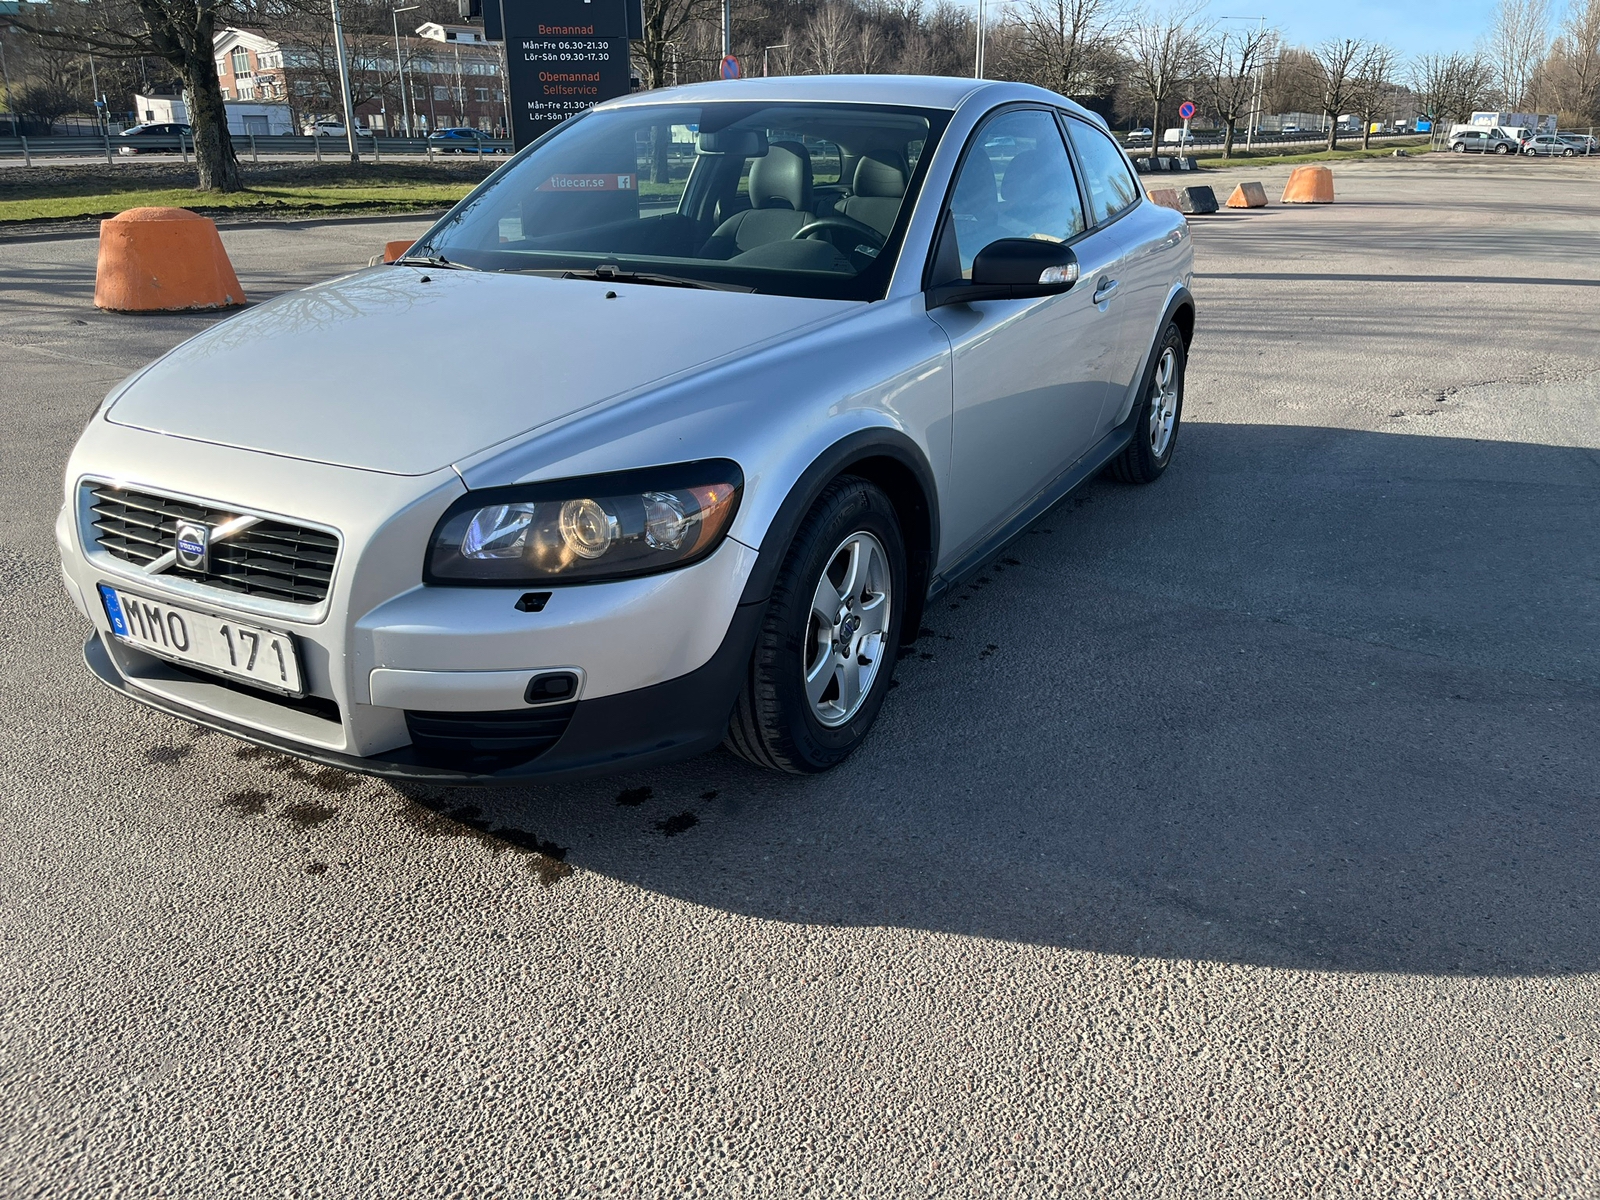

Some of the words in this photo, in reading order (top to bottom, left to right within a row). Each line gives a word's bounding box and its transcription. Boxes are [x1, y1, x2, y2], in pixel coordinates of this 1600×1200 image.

[538, 25, 594, 35] Bemannad
[522, 40, 557, 50] Mån-Fre
[558, 41, 609, 50] 06.30-21.30
[524, 53, 558, 61] Lör-Sön
[559, 53, 610, 61] 09.30-17.30
[538, 71, 600, 82] Obemannad
[543, 84, 598, 95] Selfservice
[527, 100, 561, 110] Mån-Fre
[530, 112, 563, 121] Lör-Sön
[550, 176, 605, 188] tidecar.se
[179, 542, 202, 553] VOLVO
[115, 617, 123, 629] S
[121, 596, 190, 652] MMO
[219, 624, 288, 682] 171
